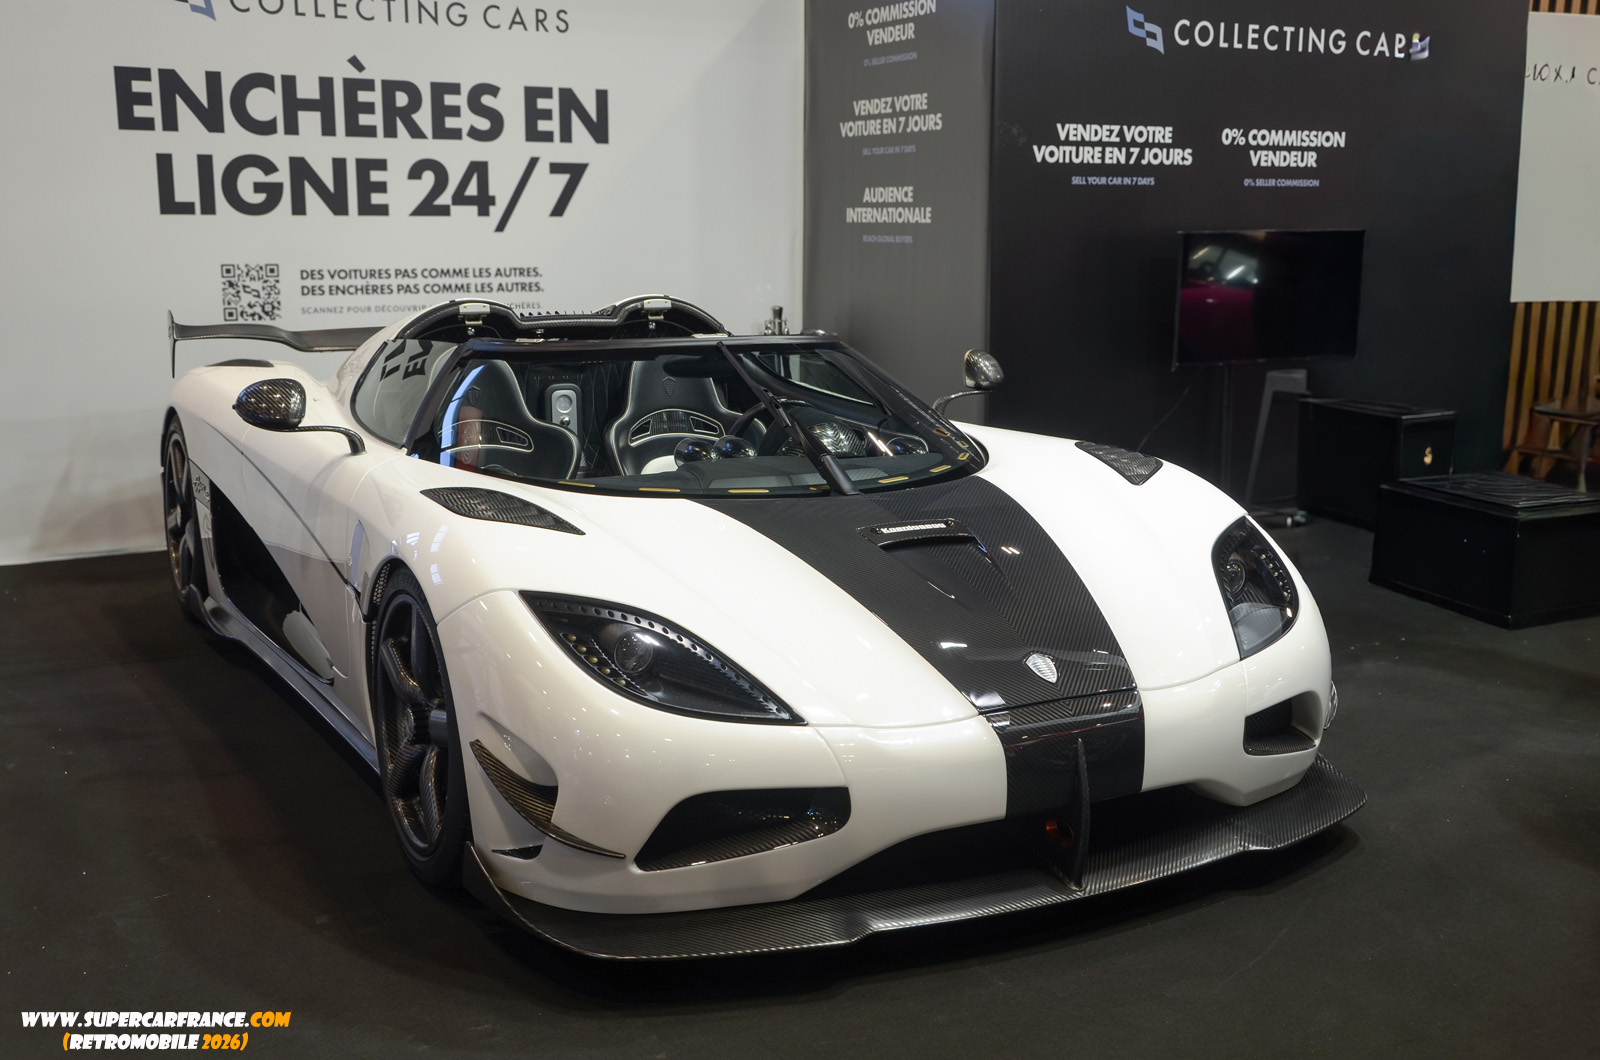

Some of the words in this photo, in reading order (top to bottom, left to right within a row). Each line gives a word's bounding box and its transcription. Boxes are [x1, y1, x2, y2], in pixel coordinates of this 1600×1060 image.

[483, 5, 569, 33] CARS
[848, 12, 864, 28] 0%
[865, 0, 937, 25] COMMISSION
[867, 22, 915, 46] VENDEUR
[1174, 19, 1346, 54] COLLECTING
[114, 55, 504, 142] ENCHÈRES
[524, 86, 609, 144] EN
[853, 97, 892, 116] VENDEZ
[894, 93, 927, 112] VOTRE
[840, 119, 881, 137] VOITURE
[883, 118, 896, 134] EN
[898, 117, 906, 133] 7
[907, 113, 942, 132] JOURS
[1057, 123, 1120, 142] VENDEZ
[1123, 125, 1173, 143] VOTRE
[1222, 128, 1245, 145] 0%
[1248, 129, 1345, 147] COMMISSION
[1033, 145, 1102, 163] VOITURE
[1105, 147, 1126, 164] EN
[1129, 147, 1140, 165] 7
[1141, 148, 1192, 165] JOURS
[1250, 150, 1317, 167] VENDEUR
[1072, 176, 1086, 184] SELL
[1087, 177, 1107, 185] YOUR
[1108, 177, 1122, 185] CAR
[1123, 177, 1131, 185] IN
[1132, 177, 1137, 185] 7
[1138, 177, 1155, 185] DAYS
[1277, 179, 1319, 187] COMMISSION
[156, 153, 389, 216] LIGNE
[408, 157, 589, 232] 24/7
[863, 186, 913, 203] AUDIENCE
[847, 207, 931, 223] INTERNATIONALE
[300, 270, 324, 280] DES
[328, 269, 391, 280] VOITURES
[395, 269, 418, 278] PAS
[421, 268, 469, 278] COMME
[473, 268, 491, 278] LES
[495, 267, 542, 277] AUTRES.
[301, 285, 325, 296] DES
[329, 281, 394, 296] ENCHÈRES
[397, 284, 420, 294] PAS
[423, 283, 471, 294] COMME
[475, 283, 493, 293] LES
[497, 282, 544, 292] AUTRES.
